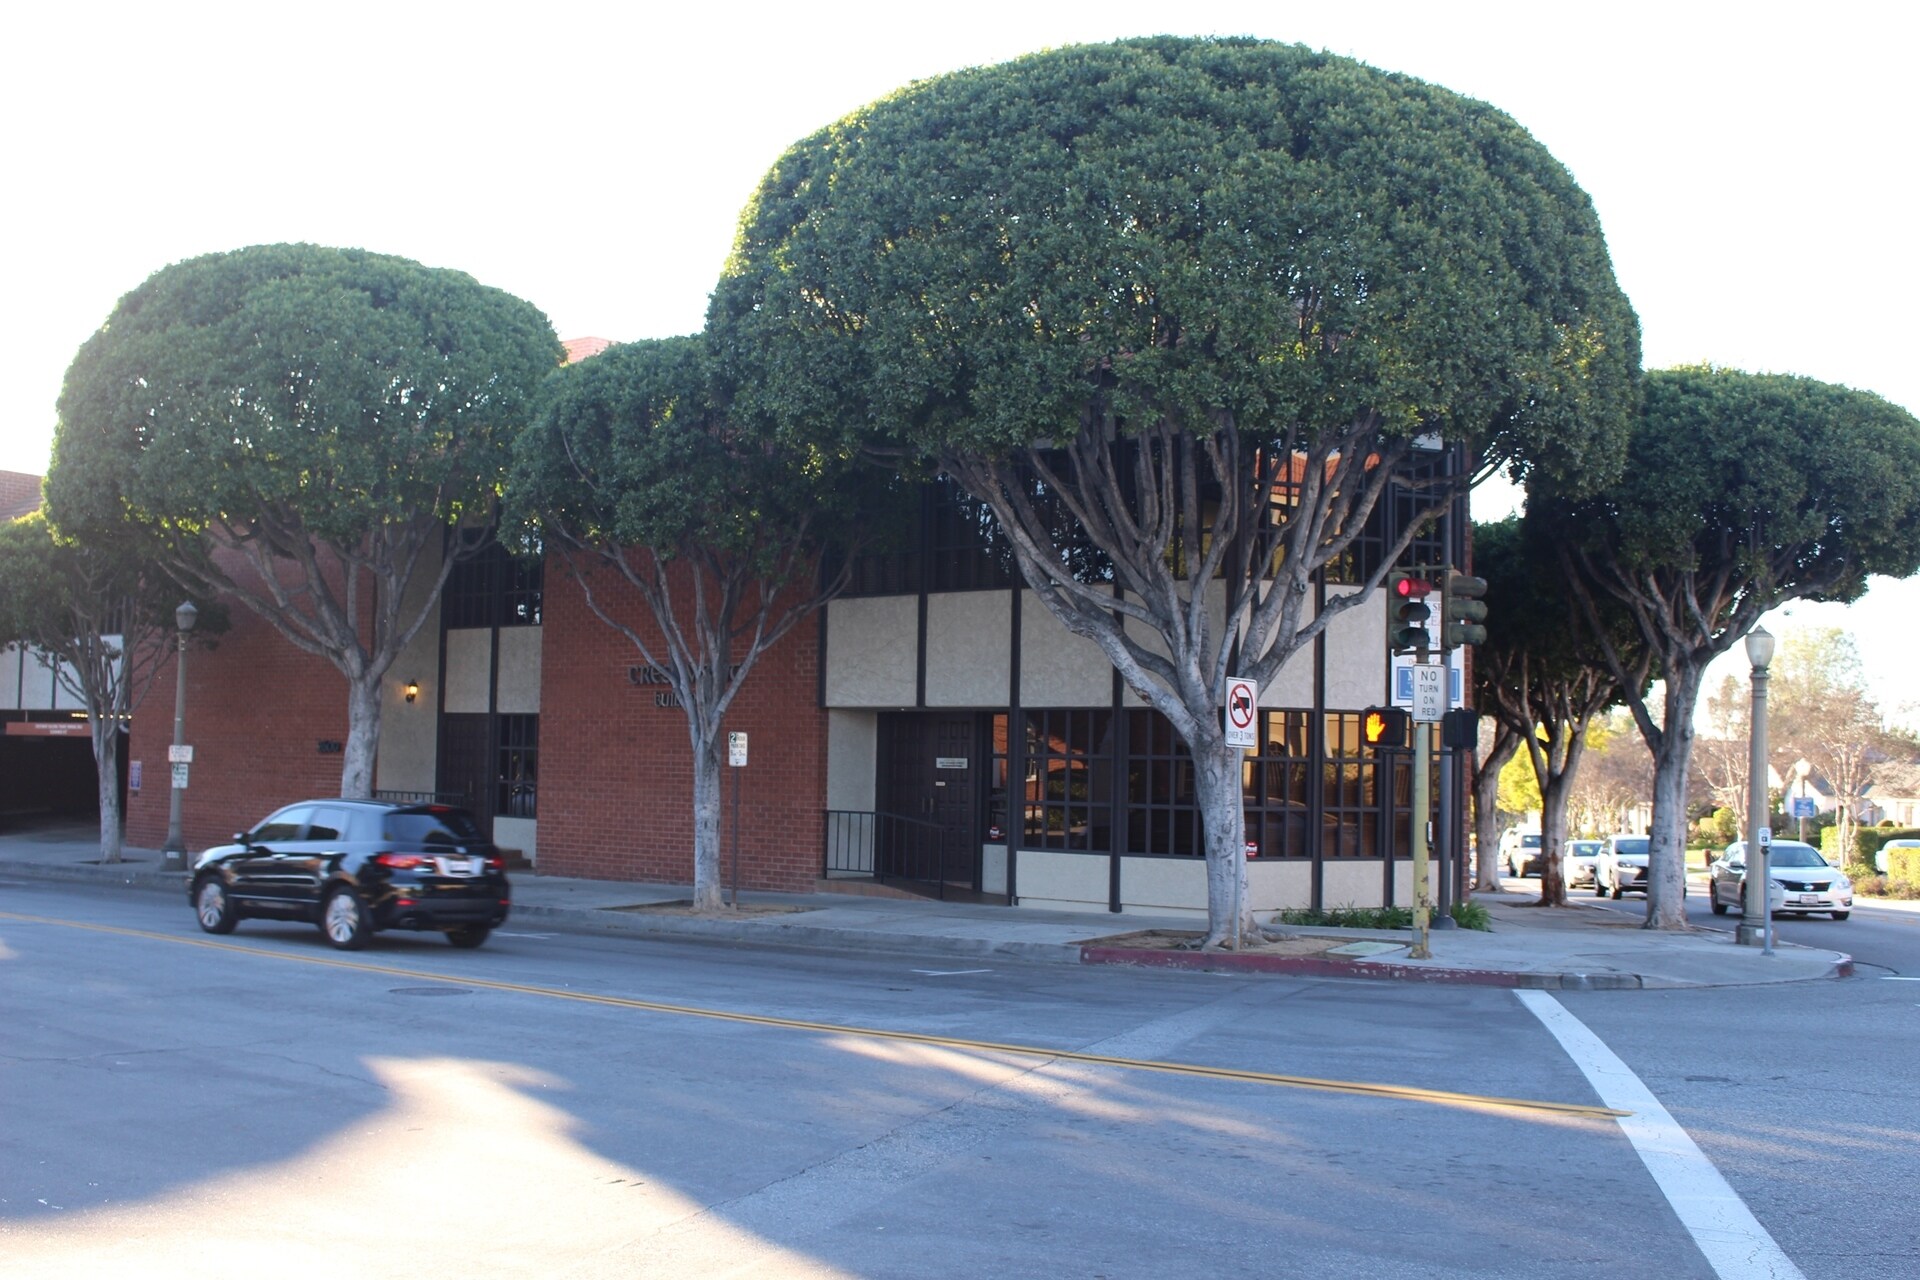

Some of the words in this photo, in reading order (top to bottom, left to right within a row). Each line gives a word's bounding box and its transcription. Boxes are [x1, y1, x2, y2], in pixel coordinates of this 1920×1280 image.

[1421, 671, 1437, 682] NO
[1419, 684, 1439, 693] TURN
[1423, 696, 1435, 704] ON
[1421, 707, 1437, 716] RED
